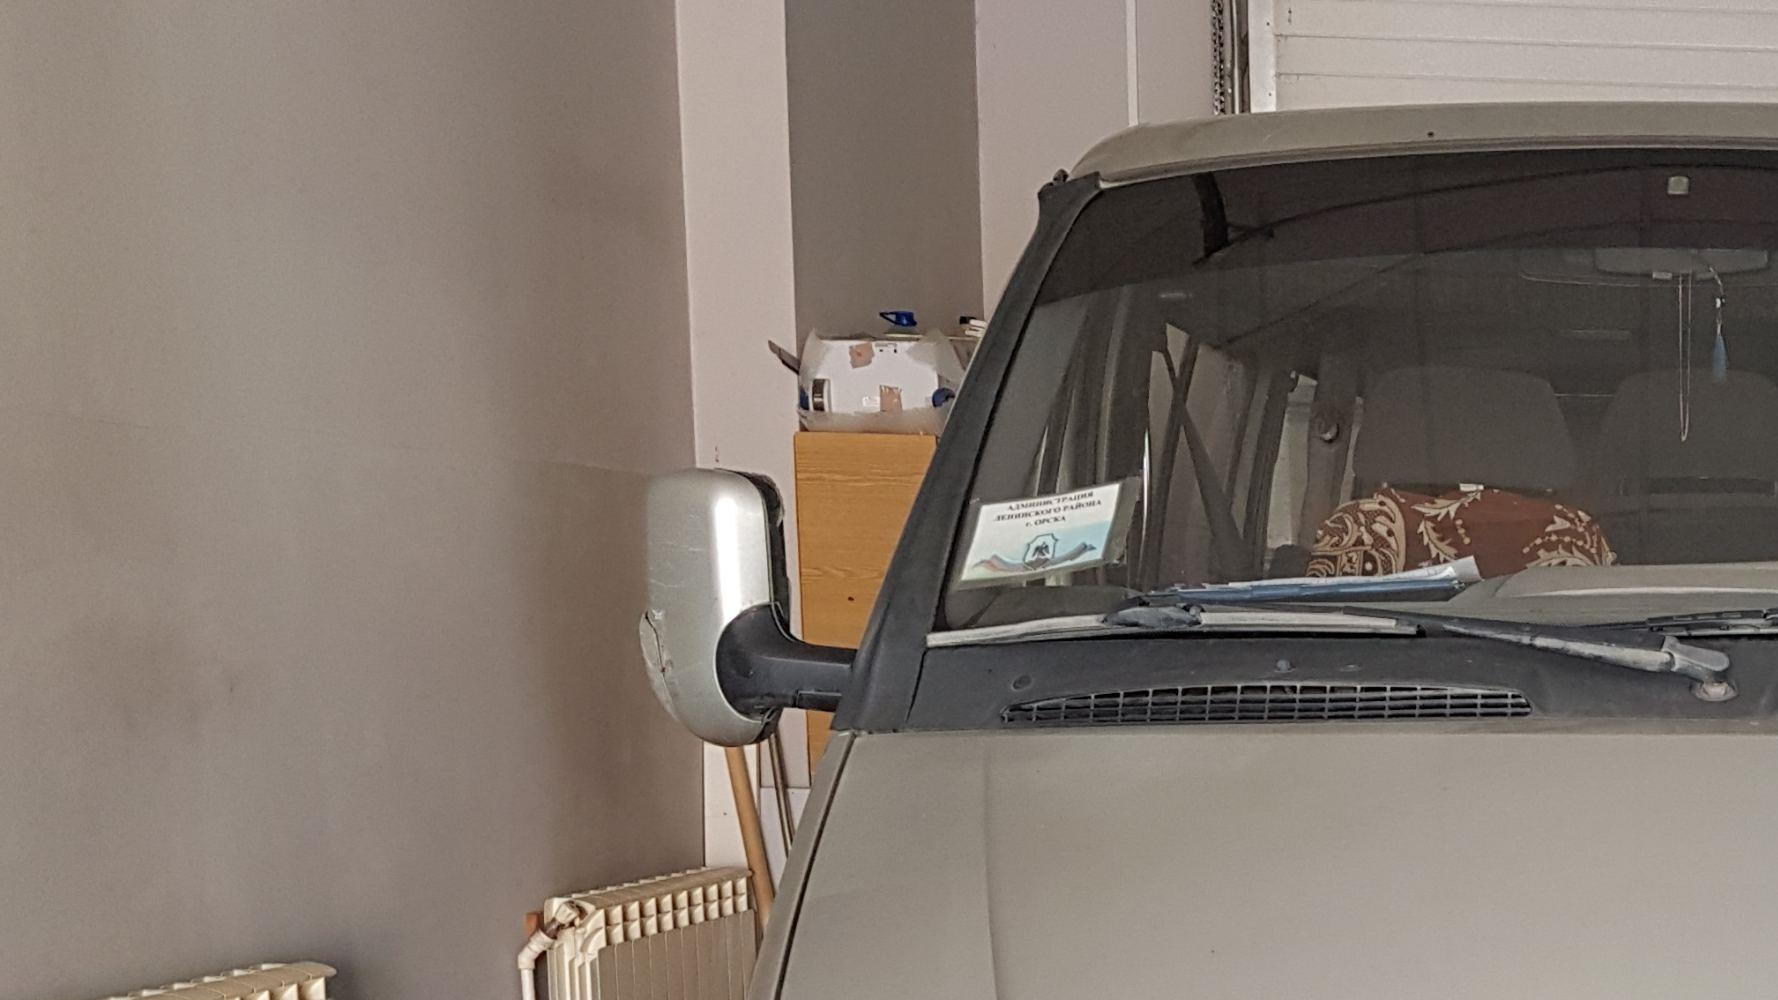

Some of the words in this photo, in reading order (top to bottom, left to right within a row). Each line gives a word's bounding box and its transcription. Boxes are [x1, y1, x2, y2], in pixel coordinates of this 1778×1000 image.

[994, 507, 1061, 521] ЛЕНИНСКОГО
[1063, 500, 1102, 512] РАЙОНА
[1008, 491, 1094, 511] АДМИНИСТРАЦИЯ
[1034, 516, 1066, 526] ОРСКА
